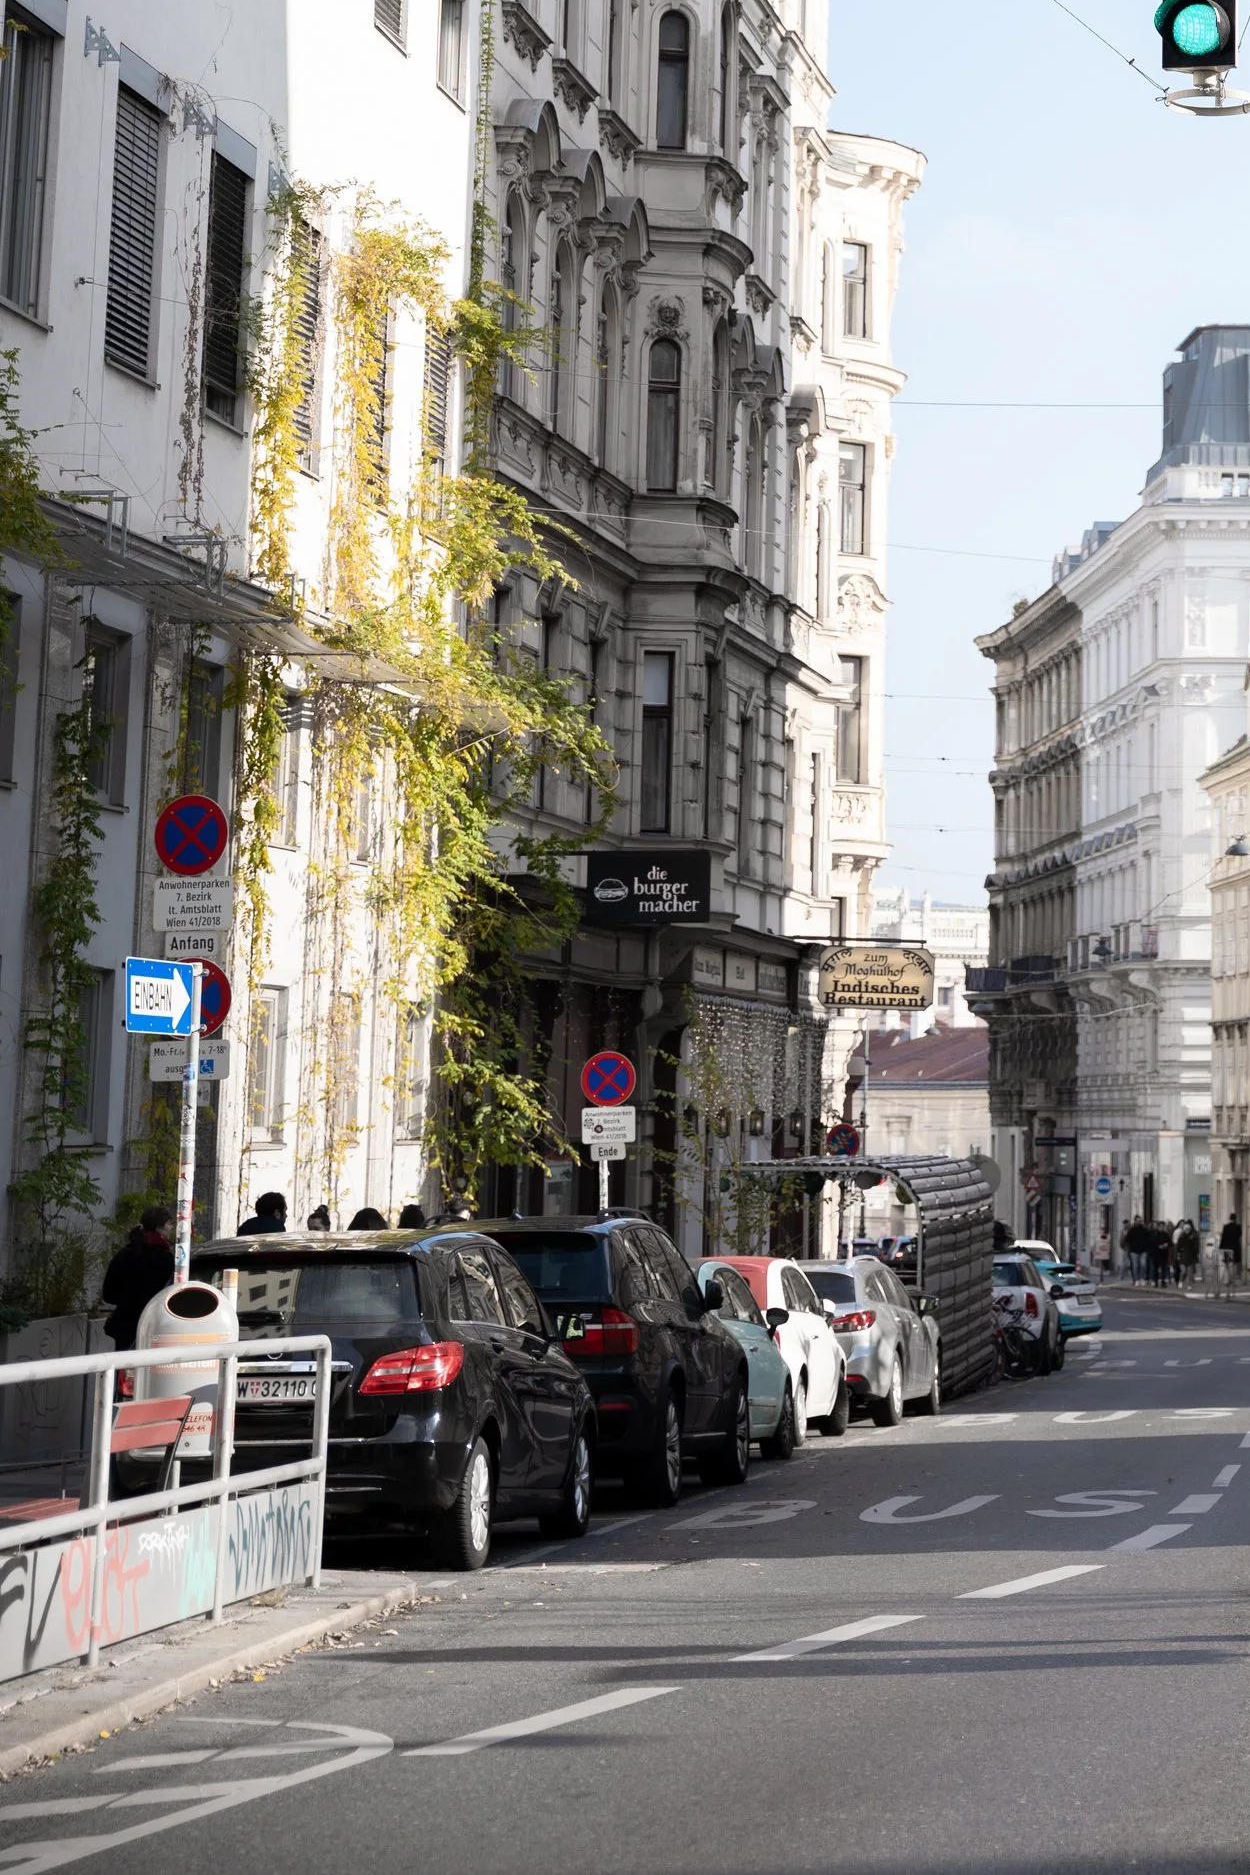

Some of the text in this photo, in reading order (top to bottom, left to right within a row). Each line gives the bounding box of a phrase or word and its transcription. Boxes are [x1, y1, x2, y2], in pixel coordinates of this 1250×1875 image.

[647, 866, 668, 880] die
[159, 879, 230, 891] Anwohnerparken
[633, 877, 689, 900] burger
[176, 892, 212, 902] 7. Bezirk
[639, 895, 700, 912] macher
[180, 905, 222, 915] Amtsblatt
[166, 916, 221, 927] Wien 41/2018
[170, 936, 214, 952] Anfang
[832, 980, 920, 995] Indisches
[134, 981, 172, 1012] EINBAHN
[823, 991, 927, 1007] Restaurant
[165, 1065, 184, 1075] ausg
[598, 1146, 618, 1157] Ende
[260, 1380, 307, 1398] 32110
[935, 1407, 1241, 1427] BUS
[672, 1489, 1159, 1528] BUS
